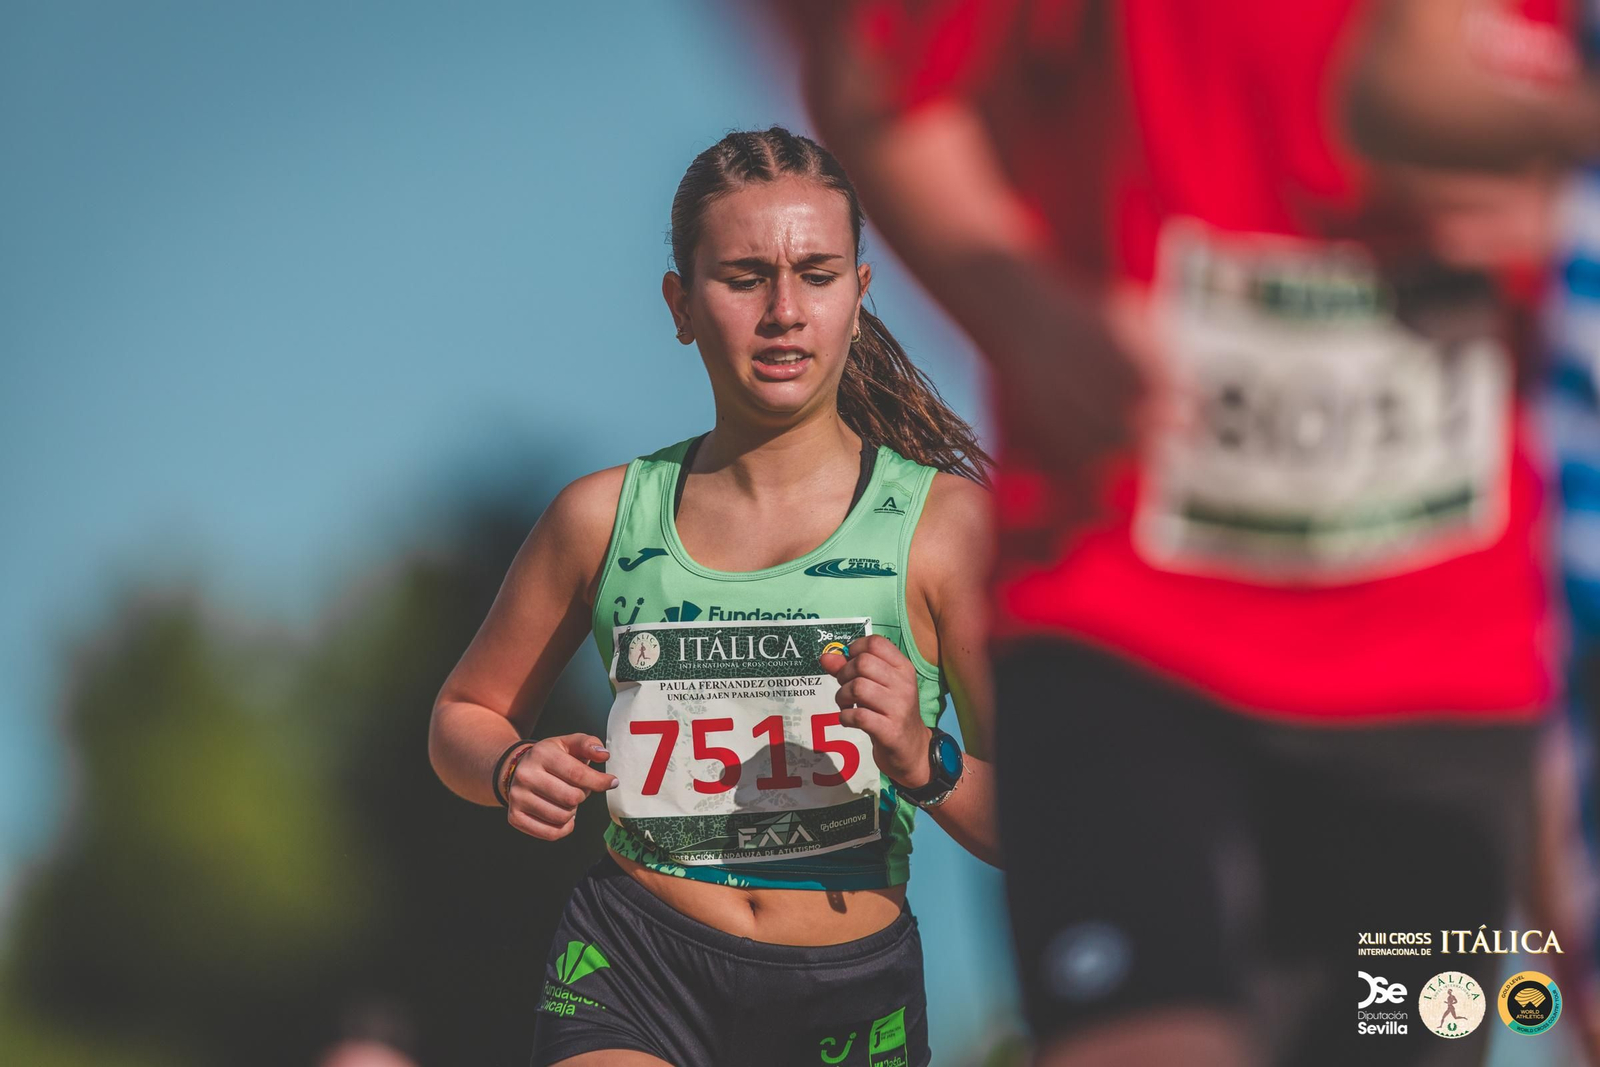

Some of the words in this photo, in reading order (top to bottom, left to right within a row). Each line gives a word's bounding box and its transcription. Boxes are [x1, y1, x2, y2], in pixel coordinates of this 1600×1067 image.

[678, 629, 802, 662] ITÁLICA
[680, 661, 740, 669] INTERNATIONAL
[660, 681, 697, 691] PAULA
[699, 679, 766, 690] FERNANDEZ
[768, 676, 822, 688] ORDOÑEZ
[667, 692, 705, 701] UNICAJA
[706, 691, 730, 700] JAEN
[731, 690, 771, 699] PARAISO
[772, 689, 816, 698] INTERIOR
[629, 712, 860, 796] 7515
[829, 813, 867, 829] docunova
[718, 849, 761, 859] ANDALUZA
[764, 849, 775, 857] DE
[778, 844, 821, 855] ATLETISMO
